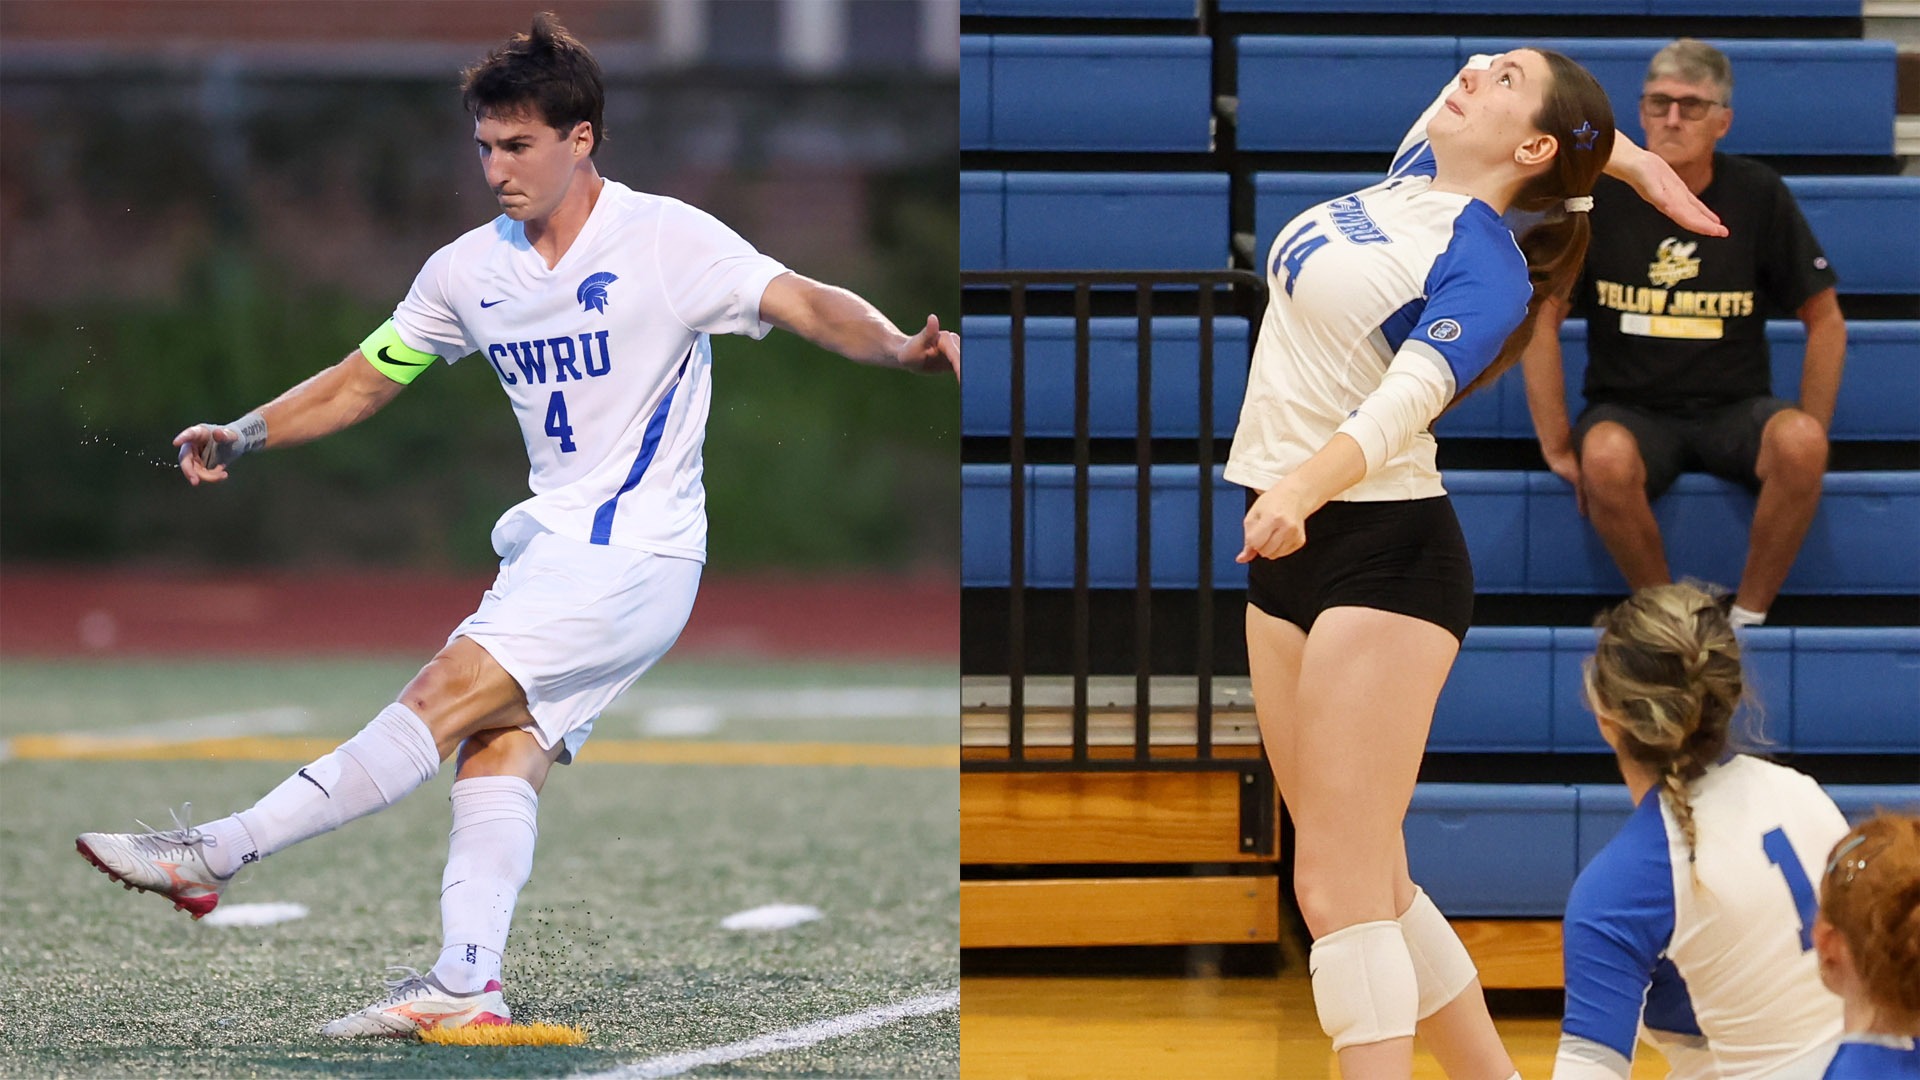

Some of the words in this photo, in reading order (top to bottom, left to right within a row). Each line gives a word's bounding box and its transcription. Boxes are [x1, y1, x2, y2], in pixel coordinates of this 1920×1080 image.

[1327, 195, 1392, 245] CWRU
[1272, 221, 1330, 300] 14
[1596, 280, 1668, 315] YELLOW
[1669, 291, 1754, 317] JACKETS
[489, 330, 611, 385] CWRU
[544, 391, 577, 453] 4
